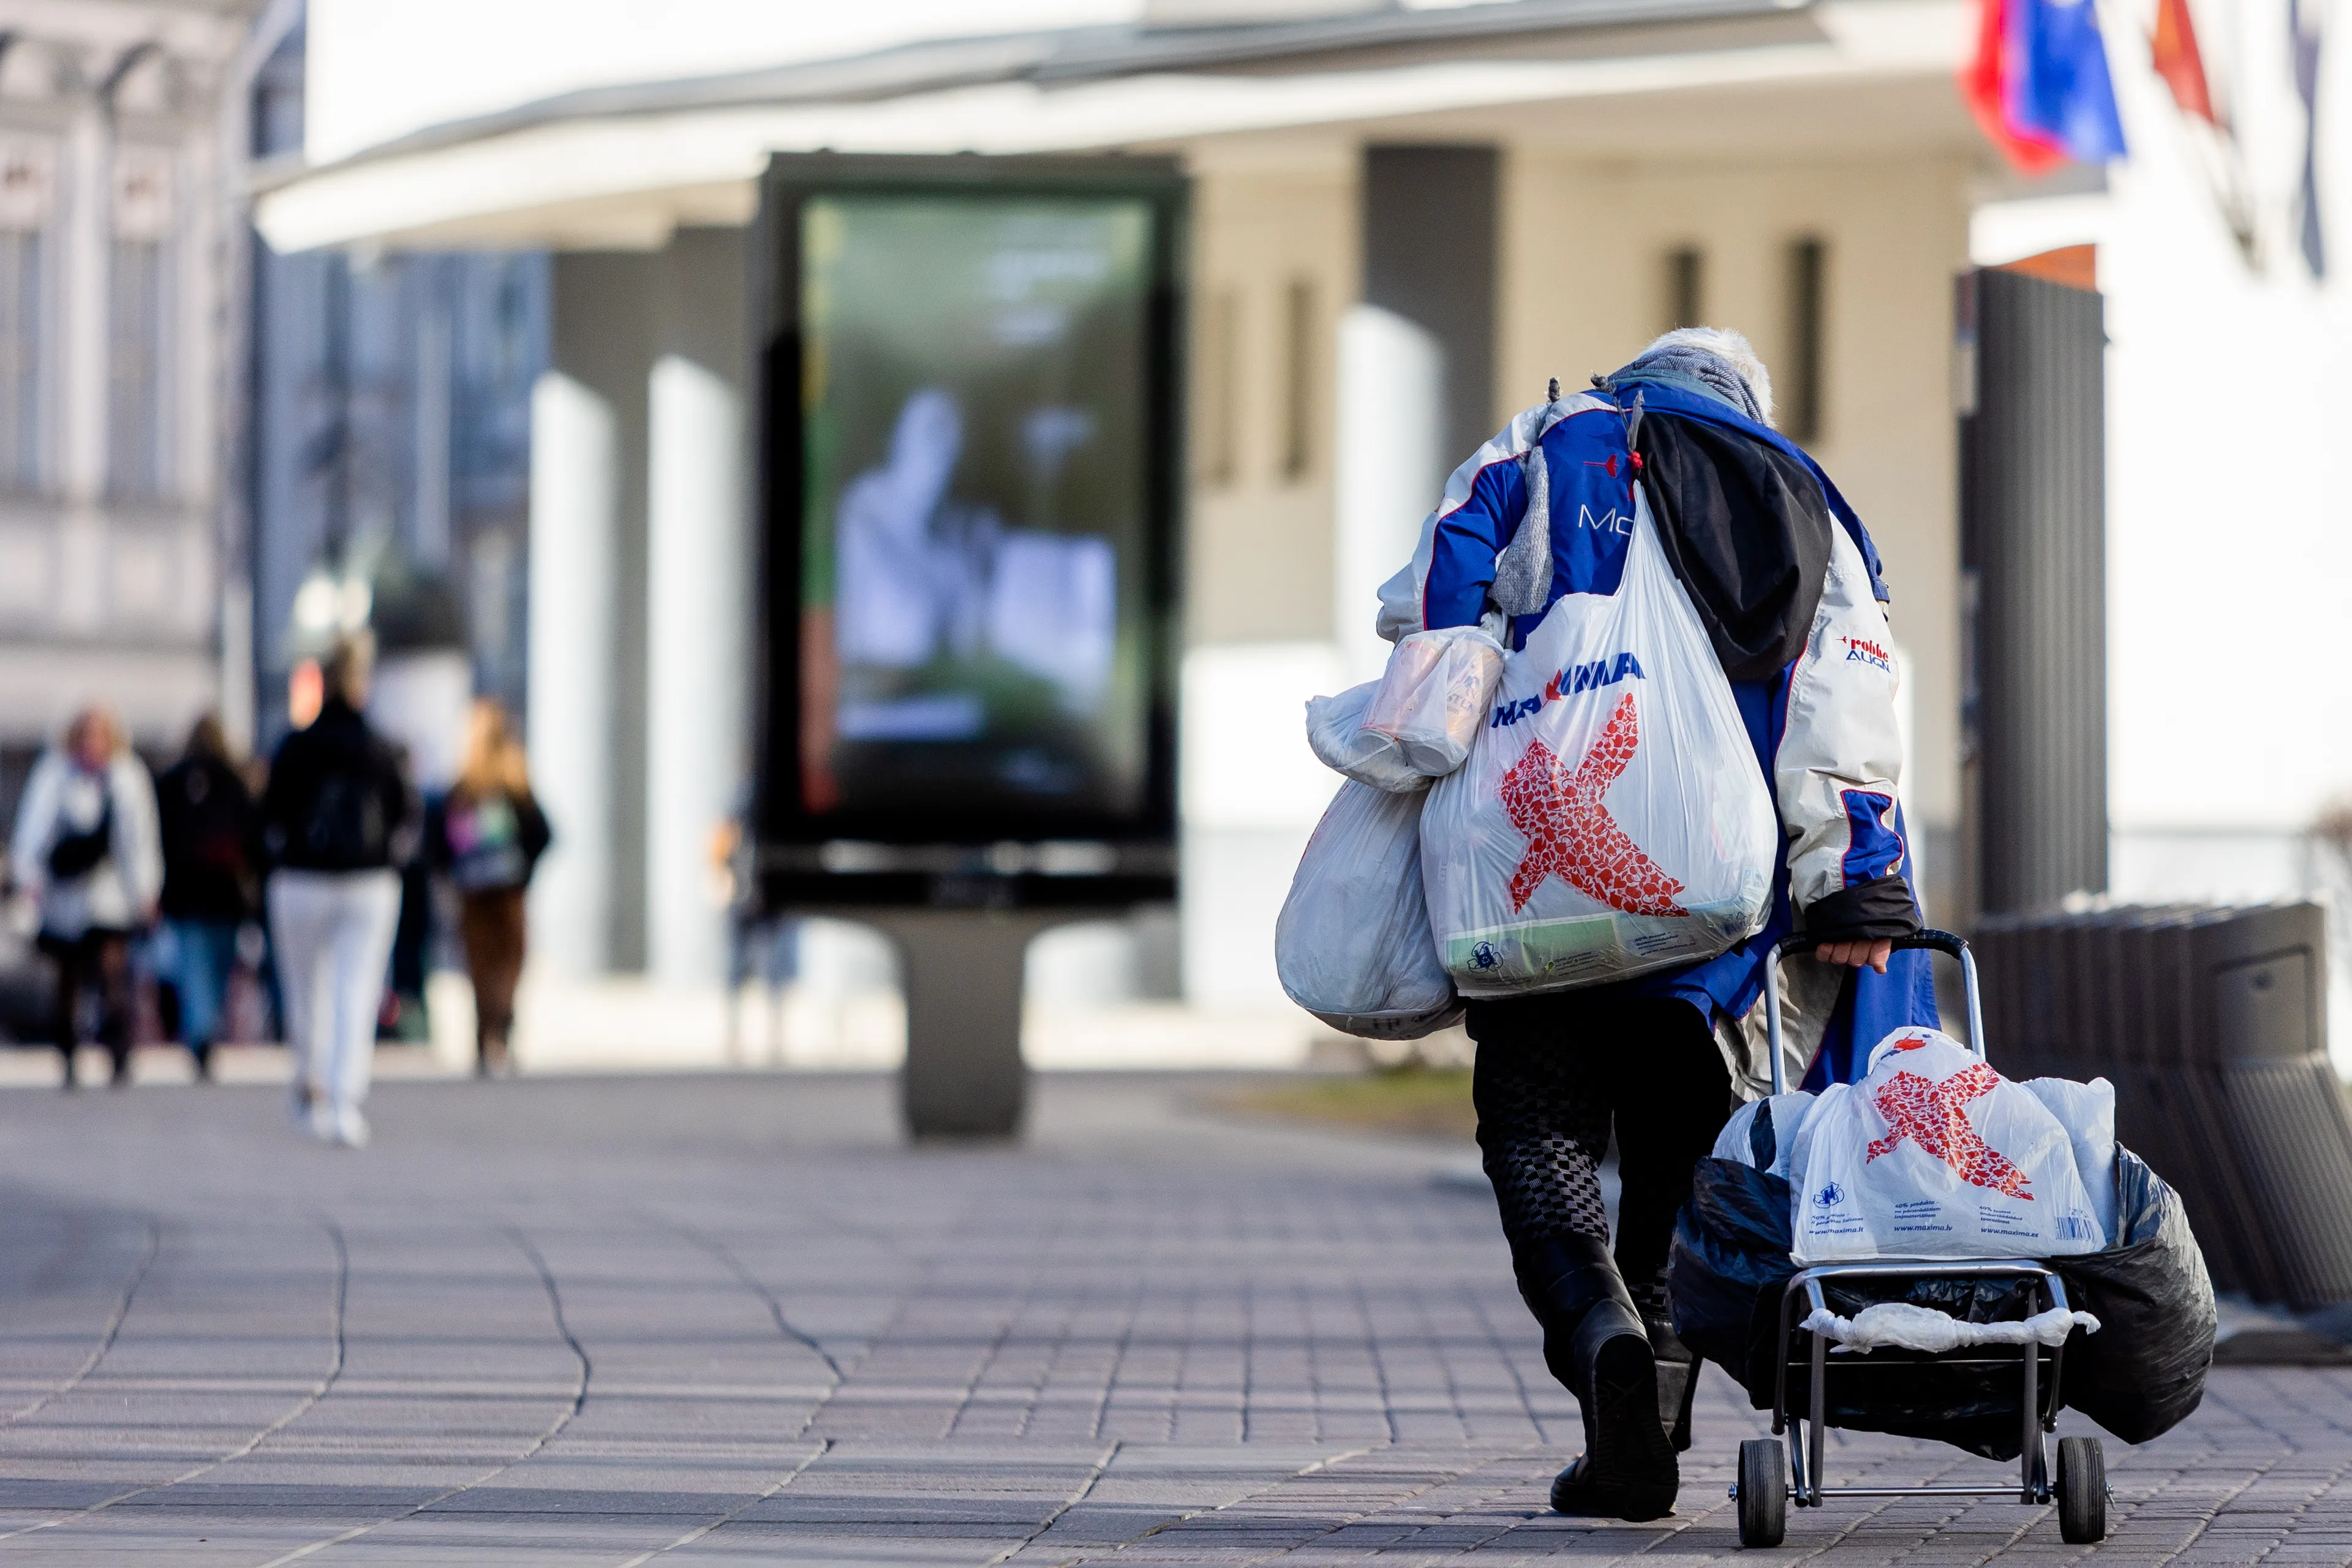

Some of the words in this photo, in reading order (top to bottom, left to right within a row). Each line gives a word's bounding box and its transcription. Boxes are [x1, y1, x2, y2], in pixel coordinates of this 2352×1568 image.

[1851, 639, 1889, 663] robbe
[1809, 1226, 1863, 1235] wwwmaxima.lt
[1981, 1227, 2039, 1238] www.maxima.ee
